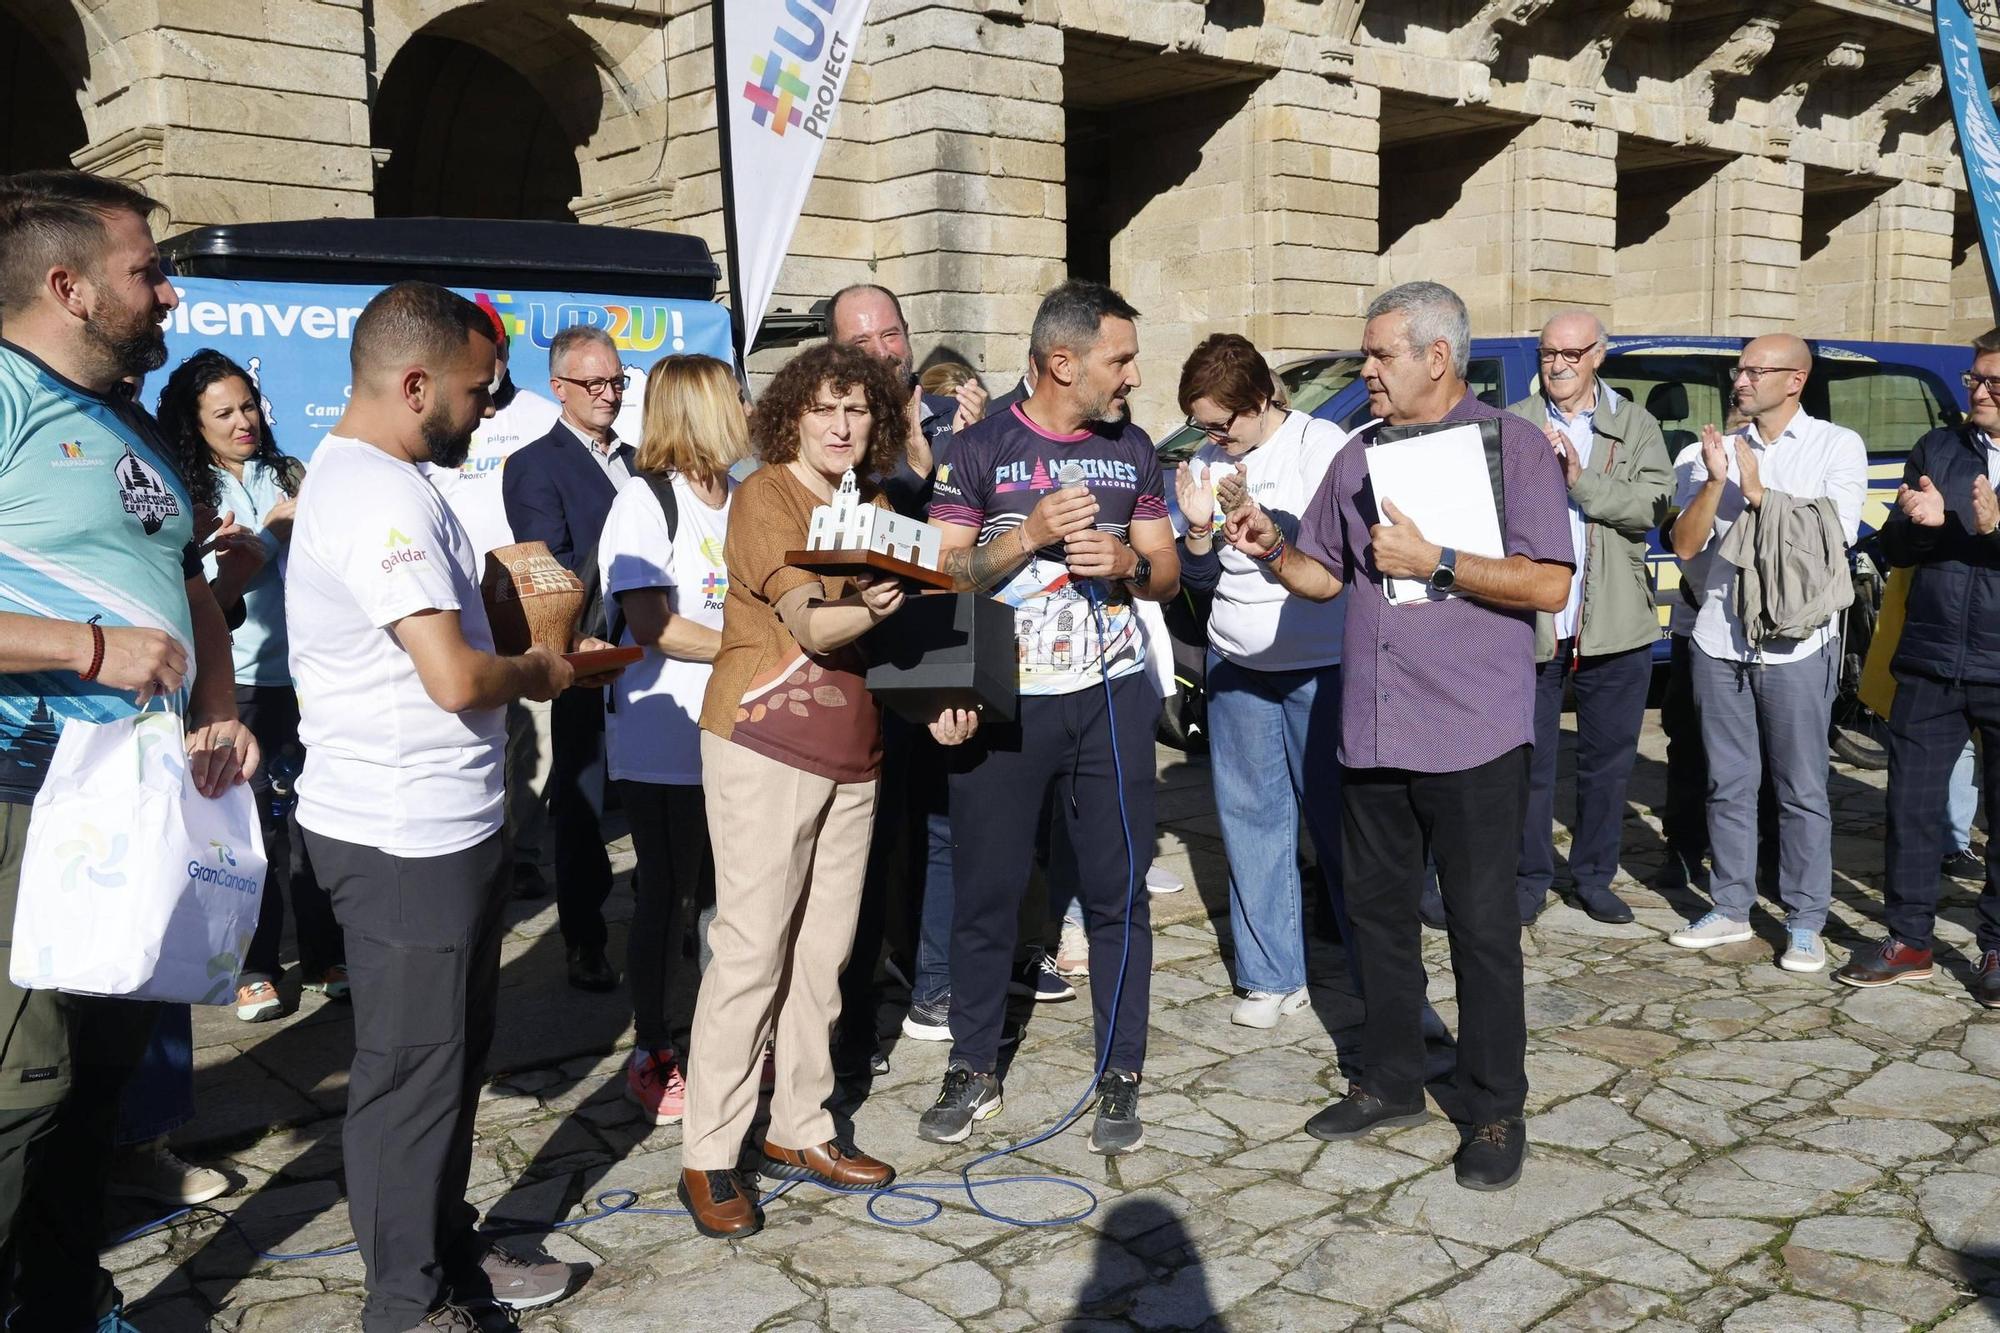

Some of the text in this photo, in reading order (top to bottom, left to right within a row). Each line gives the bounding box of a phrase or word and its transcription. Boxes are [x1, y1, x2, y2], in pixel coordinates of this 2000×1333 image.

[803, 31, 849, 140] PROJECT
[305, 403, 346, 417] Cami
[487, 434, 520, 444] pilgrim
[459, 472, 487, 480] PROJECT
[1094, 480, 1136, 490] XACOBEO
